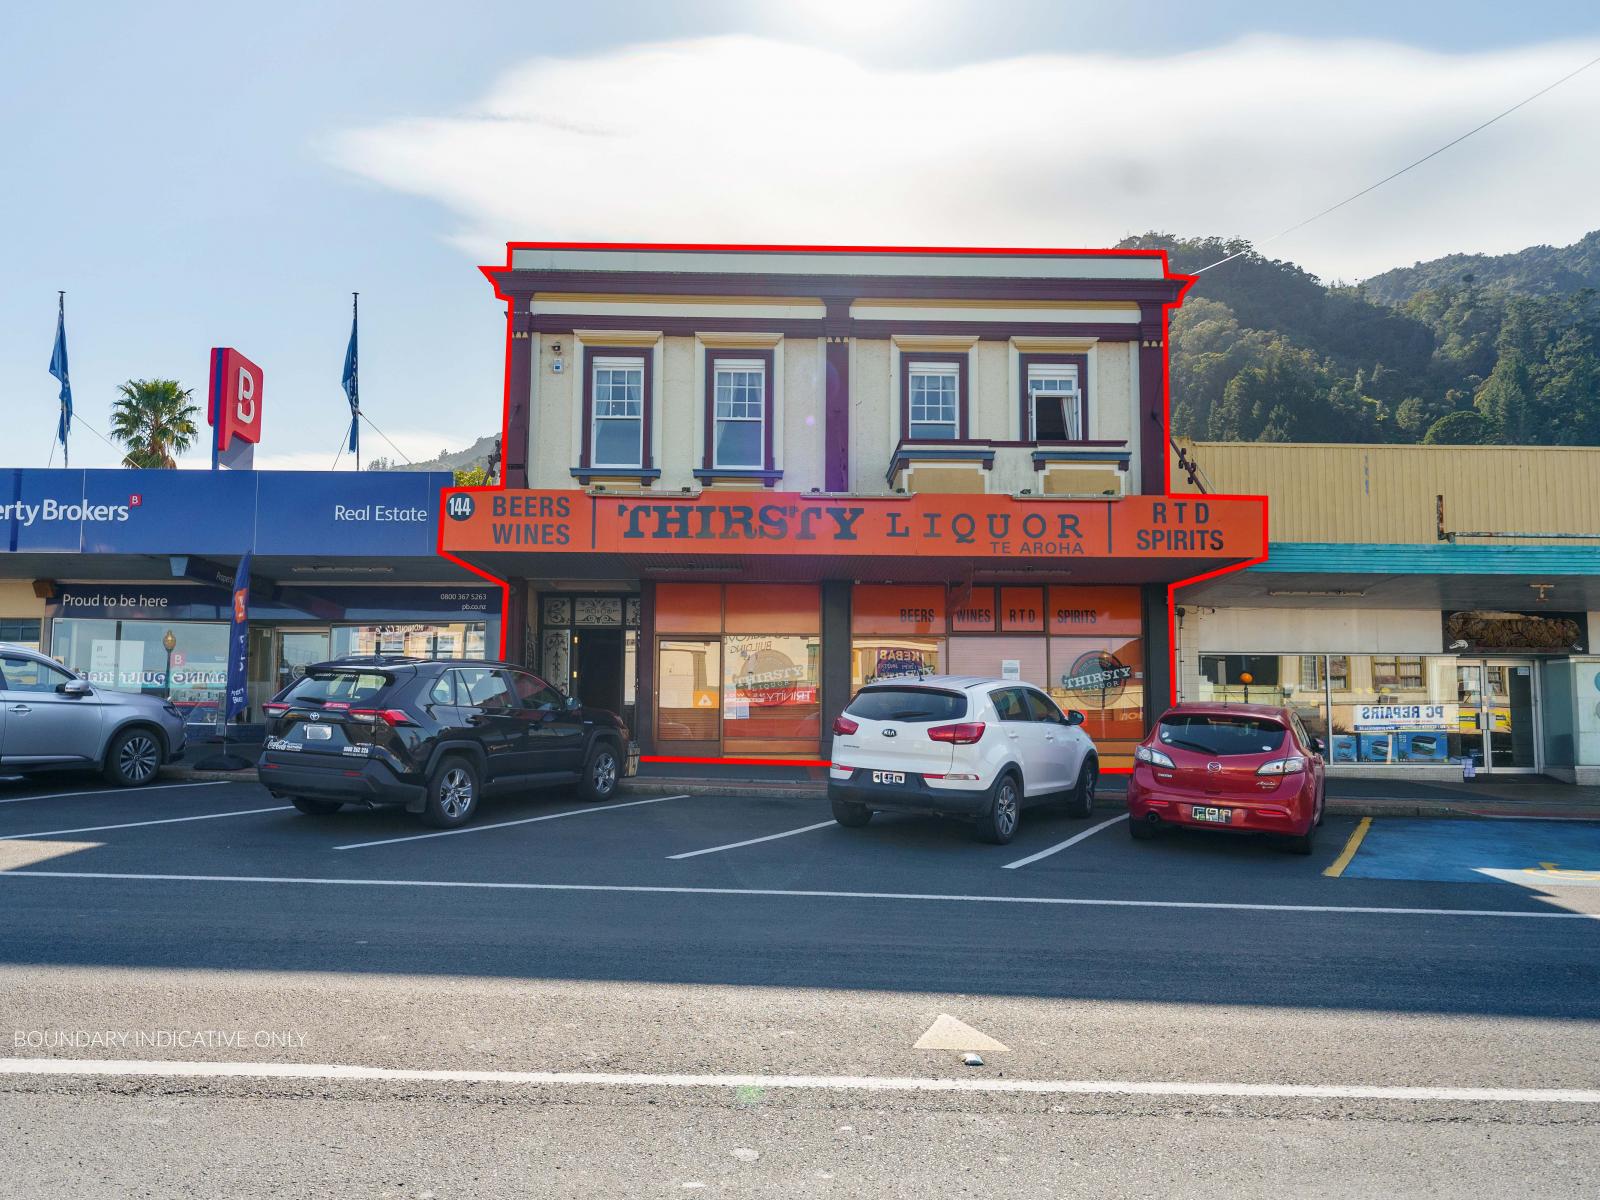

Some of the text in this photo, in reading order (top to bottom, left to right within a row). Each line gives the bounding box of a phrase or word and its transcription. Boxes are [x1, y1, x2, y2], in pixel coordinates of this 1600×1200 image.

[42, 499, 129, 522] Brokers
[334, 504, 428, 522] Real Estate
[449, 497, 472, 516] 144
[492, 495, 571, 517] BEERS
[492, 523, 571, 545] WINES
[618, 504, 1084, 544] THIRSTY LIQUOR
[989, 541, 1085, 555] TE AROHA
[1136, 529, 1224, 551] SPIRITS
[62, 593, 168, 608] Proud to be here
[462, 603, 487, 611] pb.co.nz
[900, 608, 935, 623] BEERS
[956, 608, 991, 623] WINES
[1057, 609, 1097, 624] SPIRITS
[1063, 666, 1131, 689] THIRSTY
